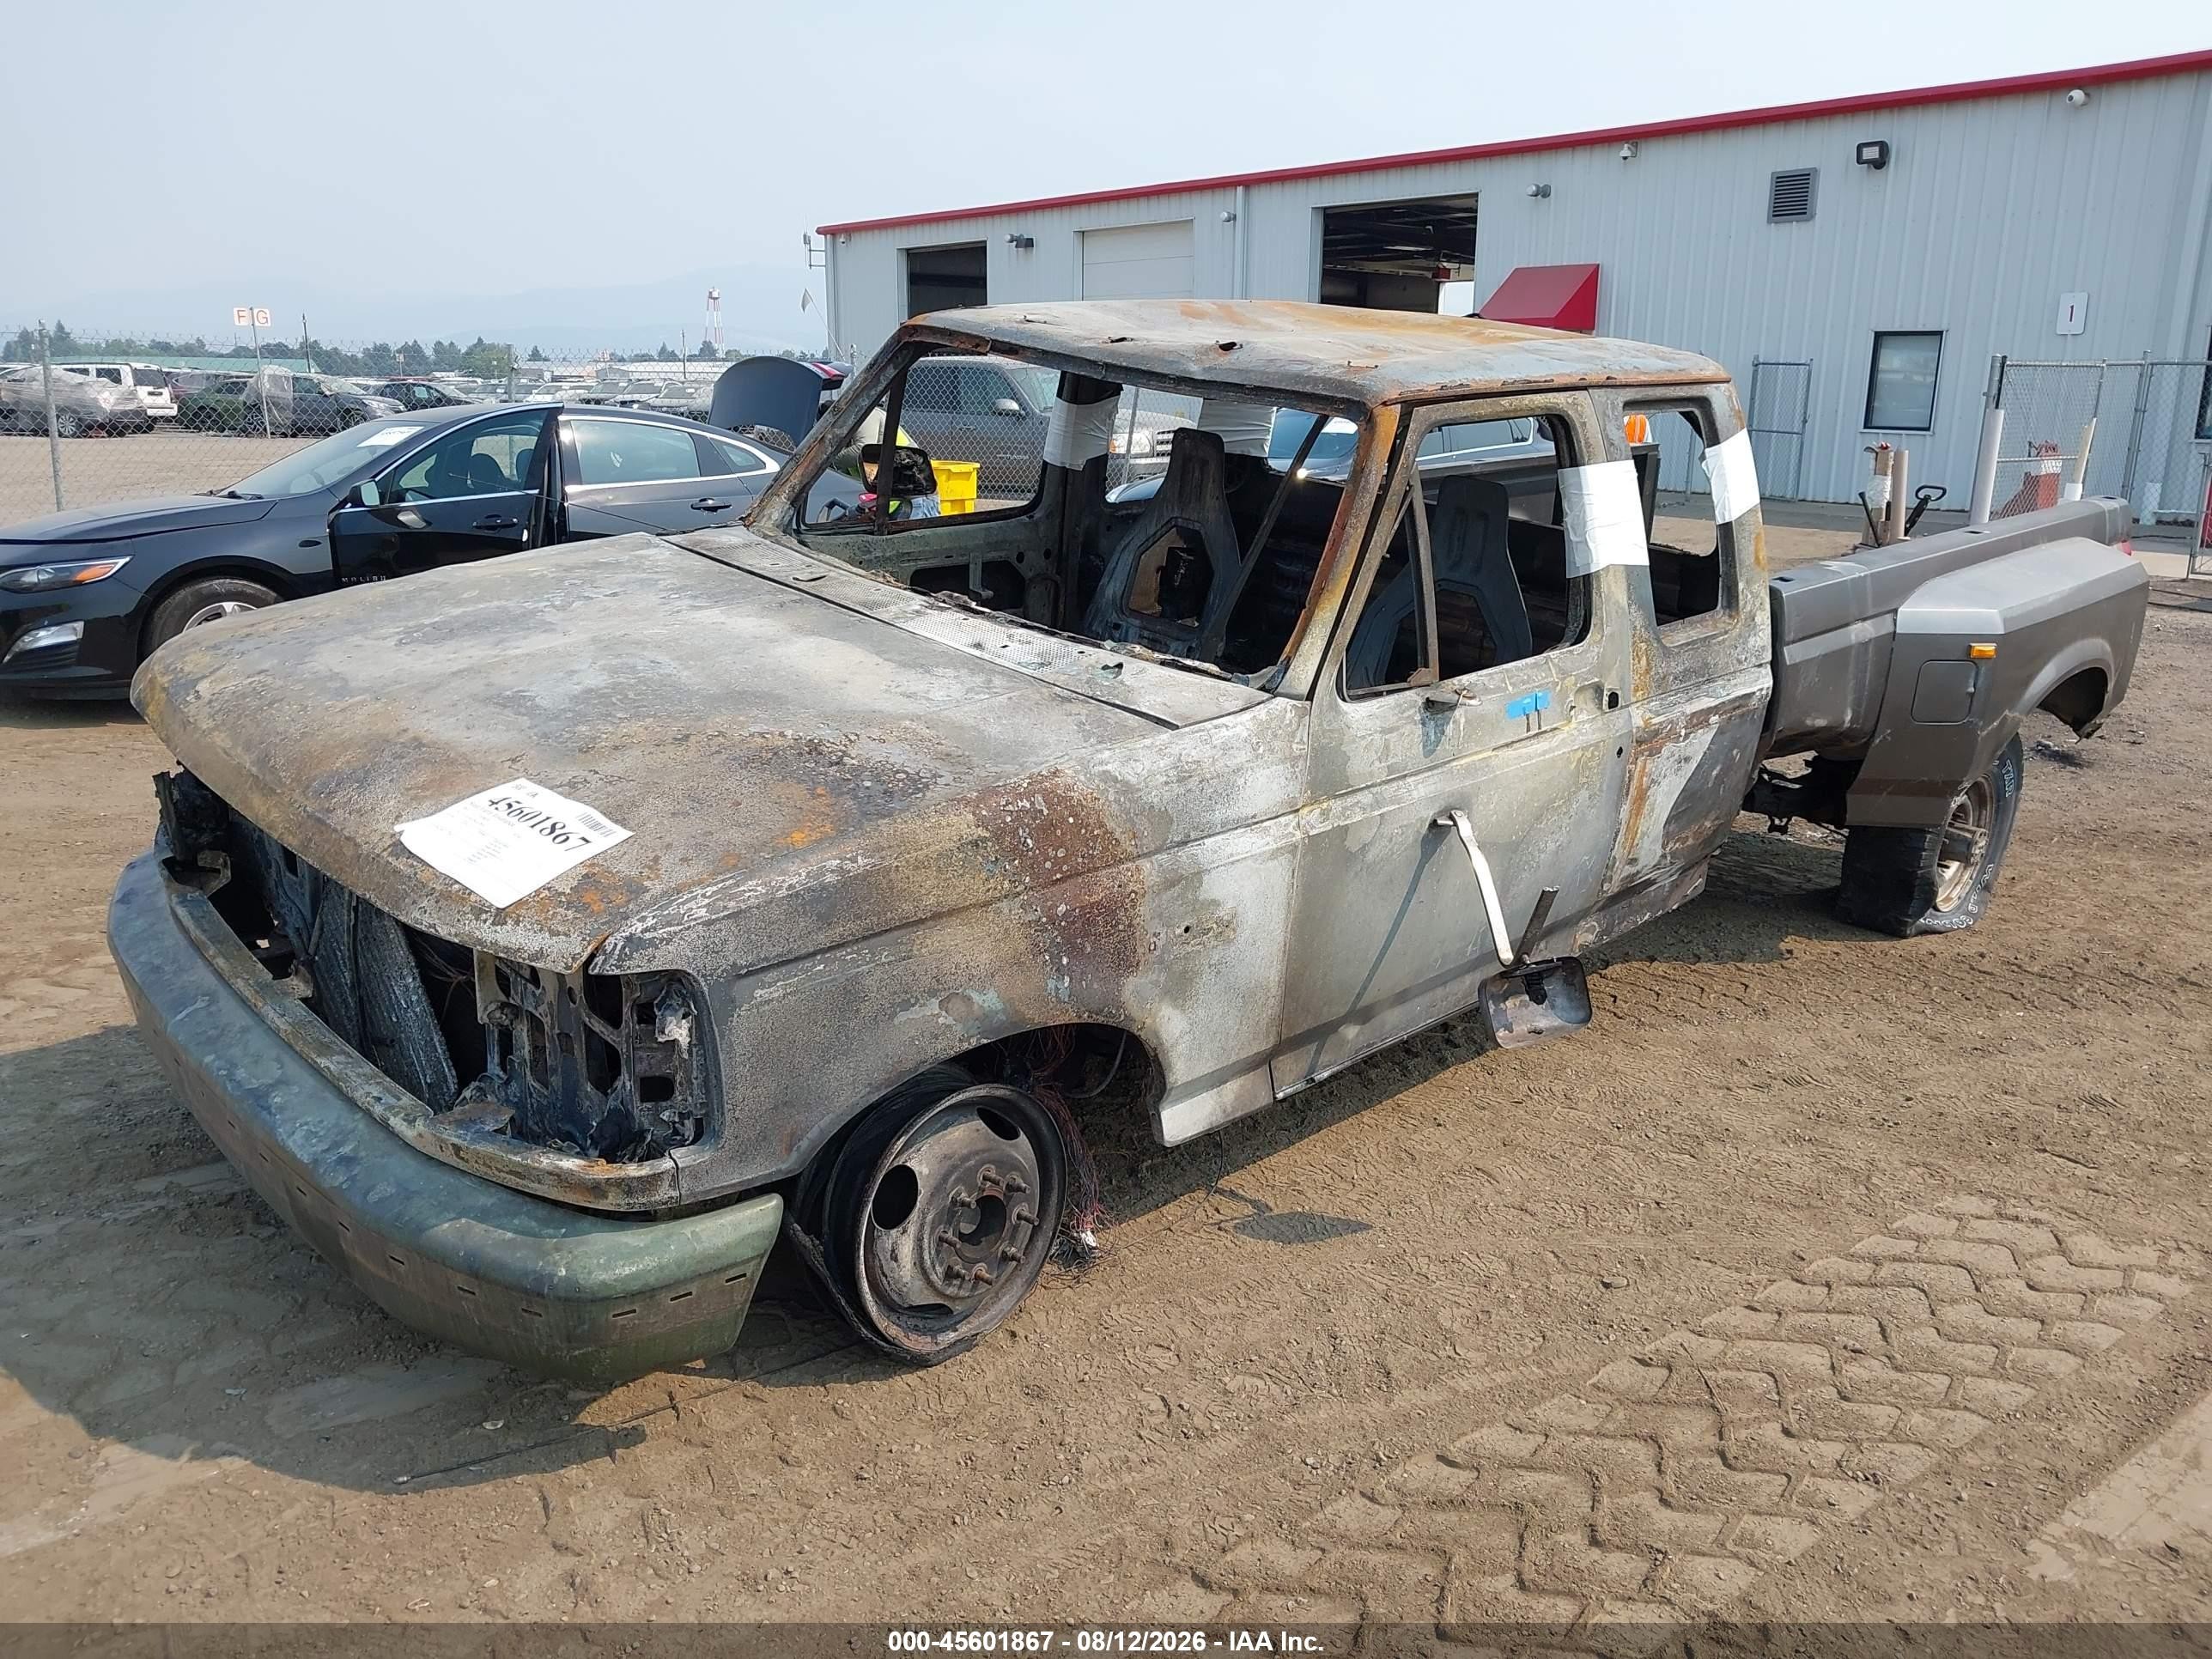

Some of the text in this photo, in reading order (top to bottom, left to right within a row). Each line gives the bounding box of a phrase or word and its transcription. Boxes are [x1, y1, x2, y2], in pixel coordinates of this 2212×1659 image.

[236, 309, 246, 324] F
[256, 309, 269, 325] G
[2069, 304, 2075, 323] 1
[488, 797, 592, 852] 45601867
